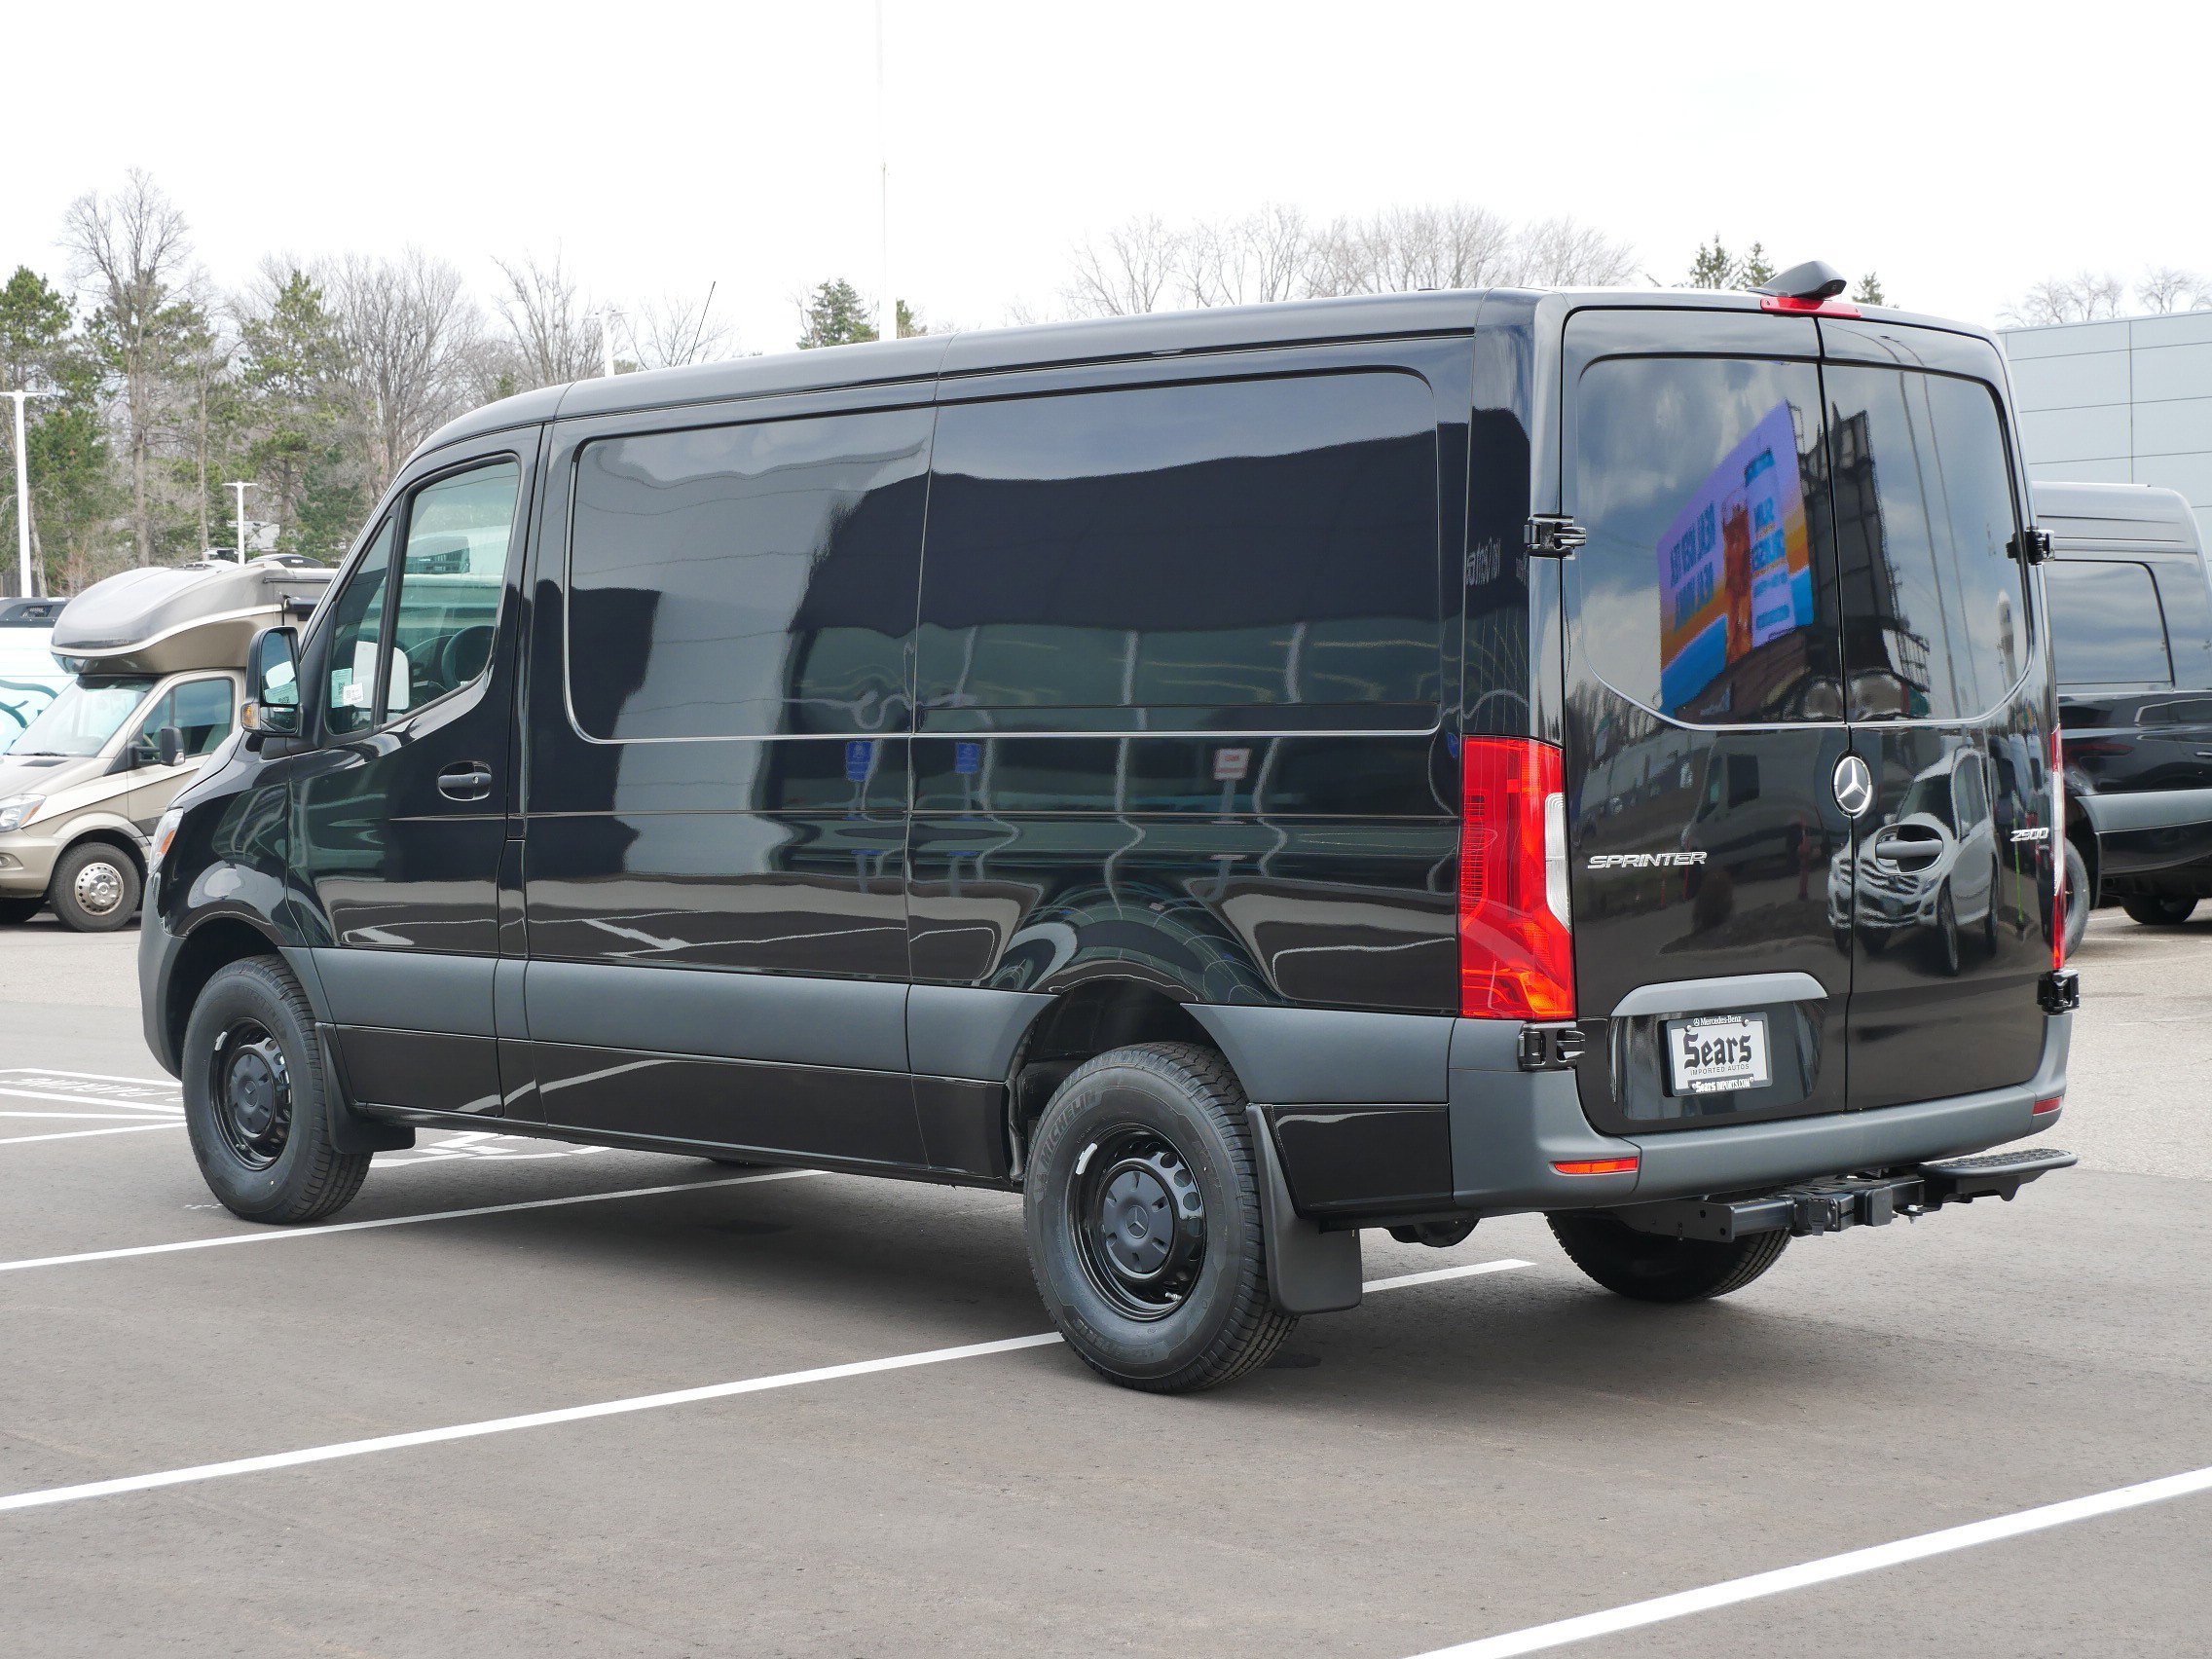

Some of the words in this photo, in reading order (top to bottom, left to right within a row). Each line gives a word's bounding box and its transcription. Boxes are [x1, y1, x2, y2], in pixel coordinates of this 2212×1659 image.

[2010, 828, 2048, 842] 2500
[1587, 851, 1707, 868] SPRINTER
[1700, 1014, 1742, 1026] Mercedes-Benz
[1682, 1032, 1752, 1069] Sears
[1690, 1066, 1725, 1076] IMPORTED
[1727, 1063, 1750, 1072] AUTOS
[1040, 1090, 1099, 1166] MICHELIN
